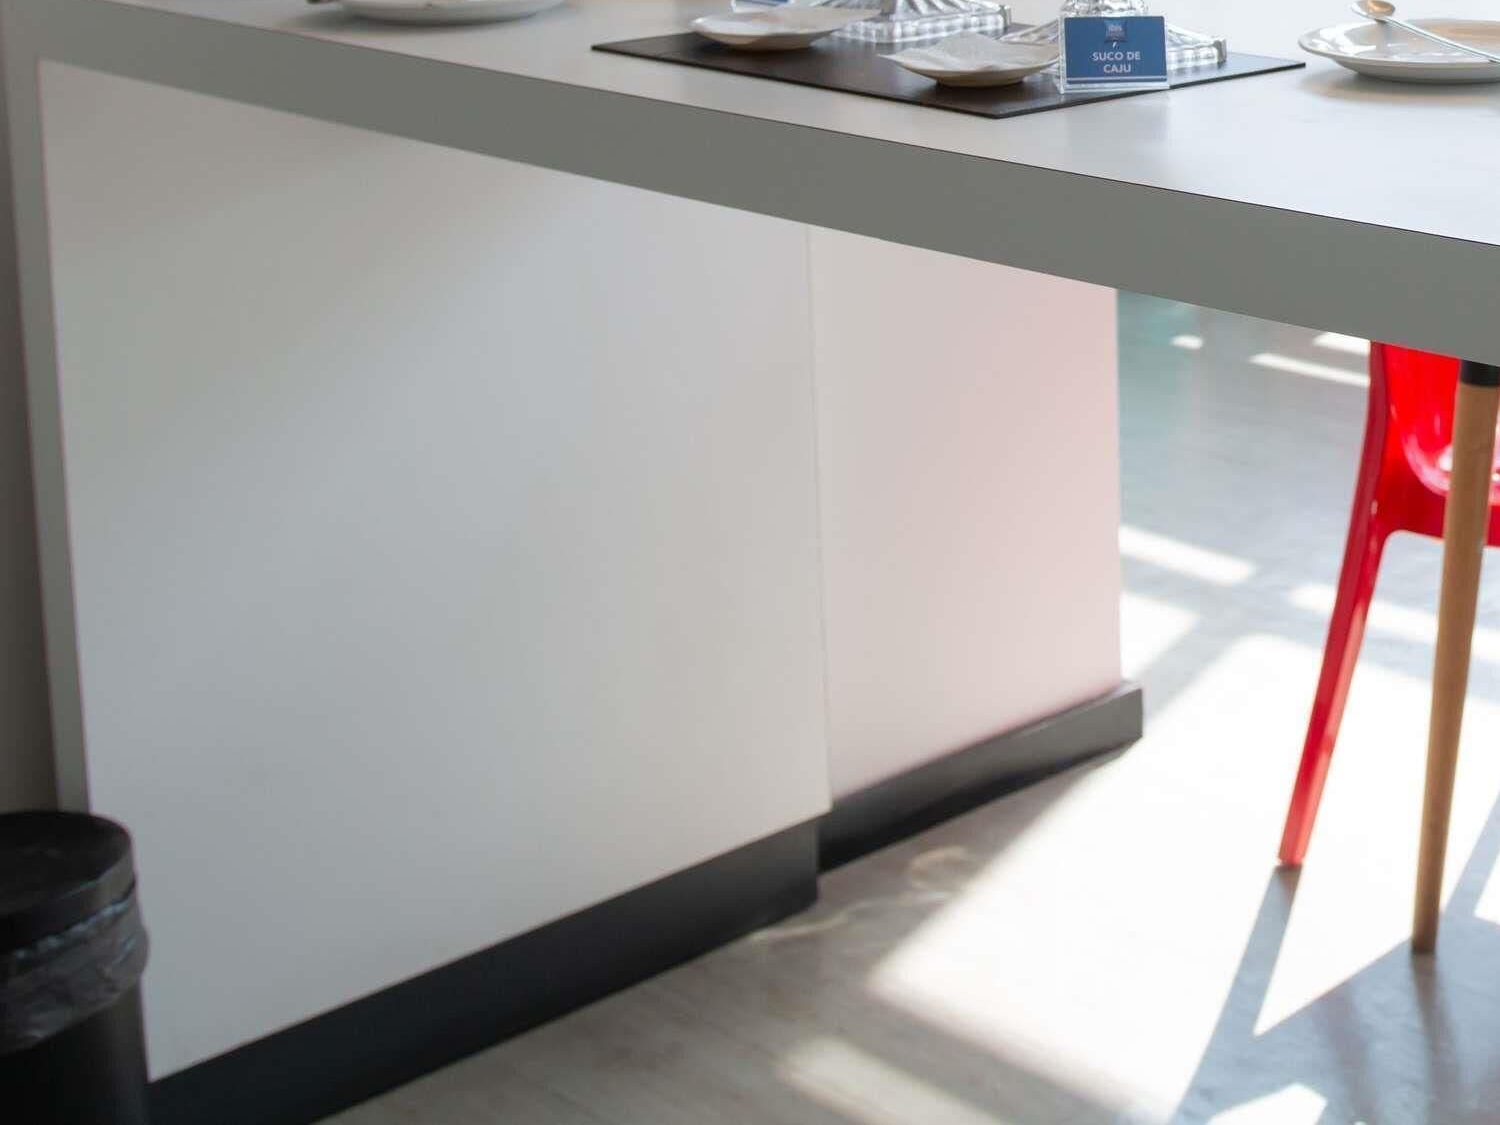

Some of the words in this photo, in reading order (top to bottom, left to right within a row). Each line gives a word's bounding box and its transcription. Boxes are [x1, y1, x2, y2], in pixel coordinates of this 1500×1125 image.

[1092, 51, 1123, 61] SUCO
[1126, 51, 1141, 61] DE
[1103, 63, 1132, 74] CAJU
